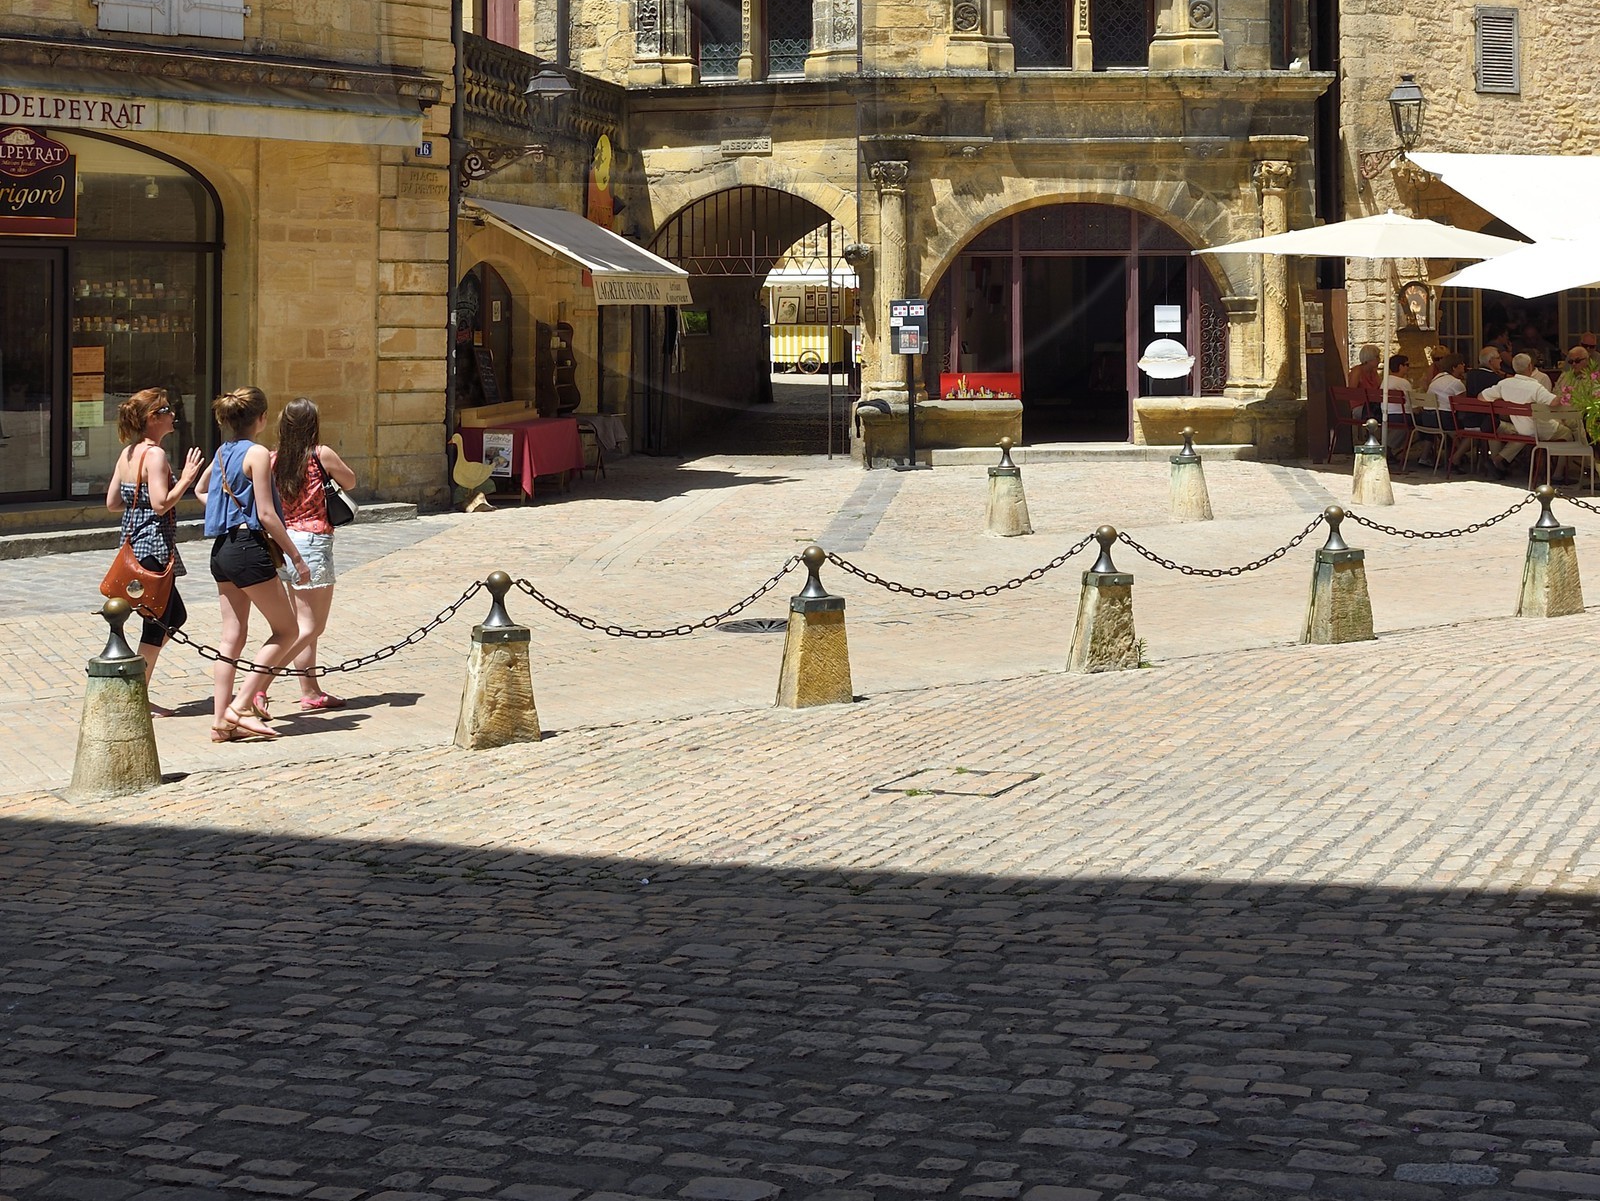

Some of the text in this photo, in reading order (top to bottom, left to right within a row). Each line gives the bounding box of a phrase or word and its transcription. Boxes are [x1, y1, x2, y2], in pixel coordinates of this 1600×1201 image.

[0, 93, 146, 128] DELPEYRAT
[0, 175, 65, 210] rigord
[644, 282, 661, 300] GRAS
